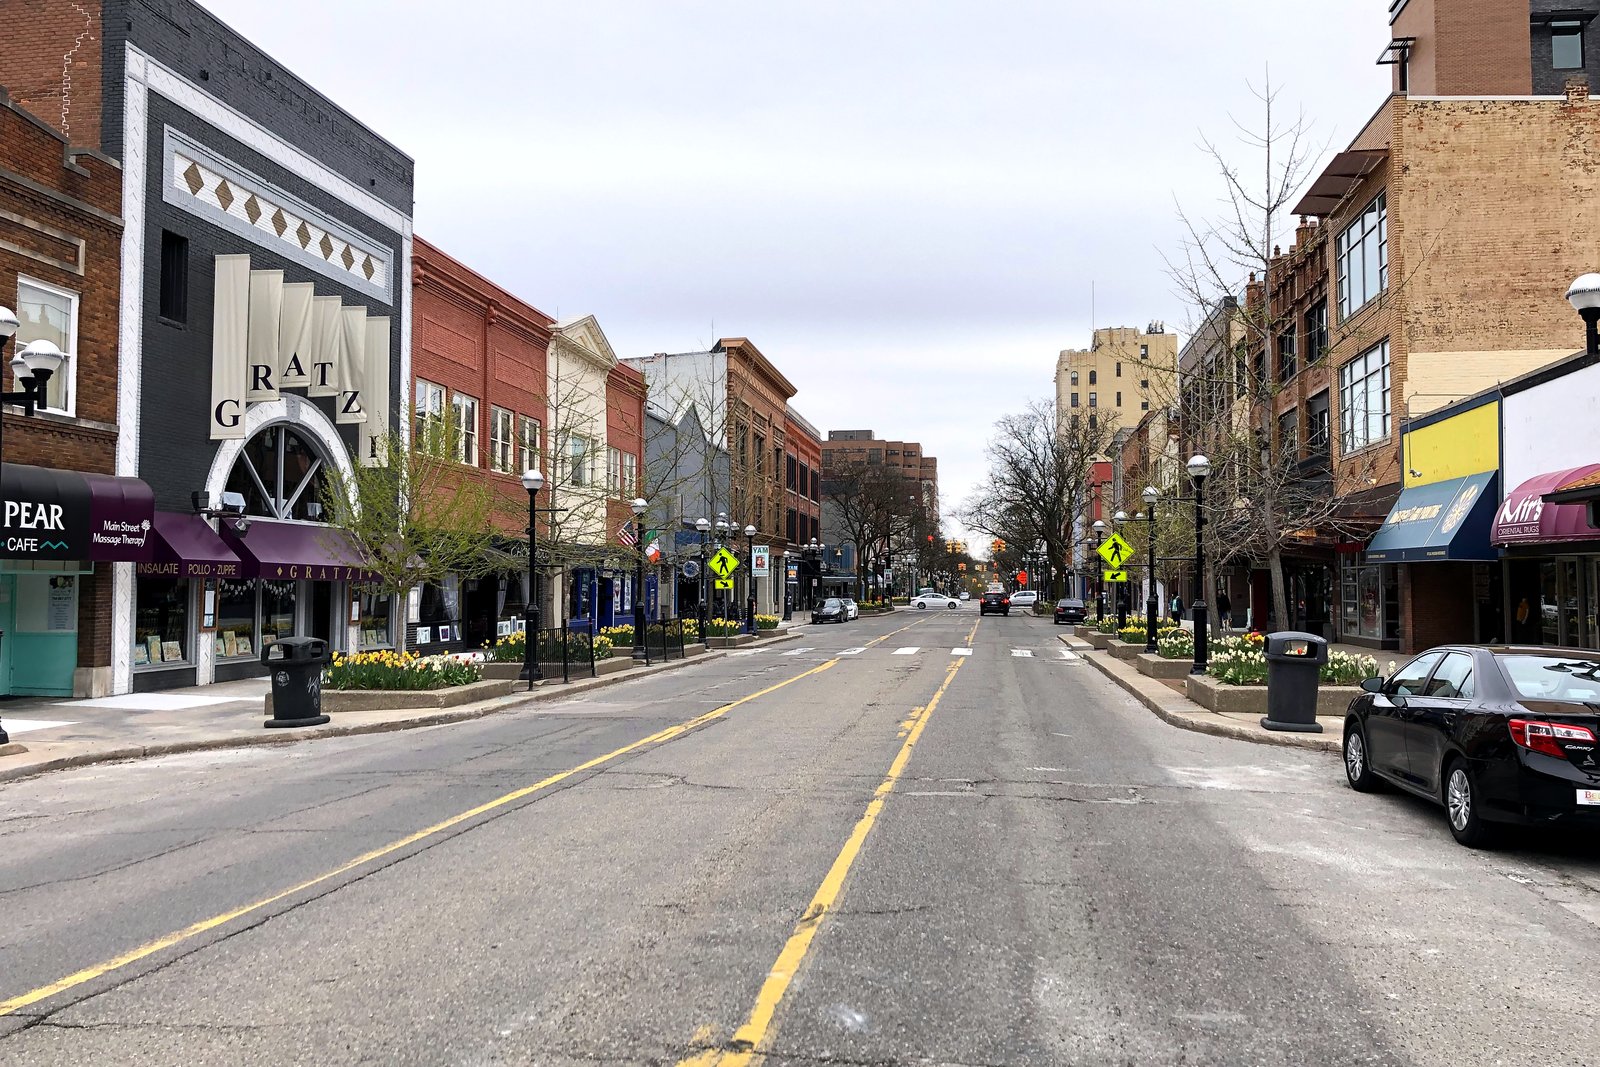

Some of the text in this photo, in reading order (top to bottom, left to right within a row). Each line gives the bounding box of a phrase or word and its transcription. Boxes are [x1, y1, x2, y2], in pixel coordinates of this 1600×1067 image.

[214, 351, 379, 459] GRATZI
[4, 500, 65, 531] PEAR
[103, 520, 140, 533] Main Street
[1497, 525, 1540, 536] ORIENTAL RUGS
[7, 537, 39, 552] CAFE
[92, 532, 145, 548] Massage Therapy
[752, 546, 769, 554] YAM
[137, 563, 179, 575] INSALATE
[188, 563, 237, 575] POLLO ZUPPE
[289, 565, 363, 580] GRATZI
